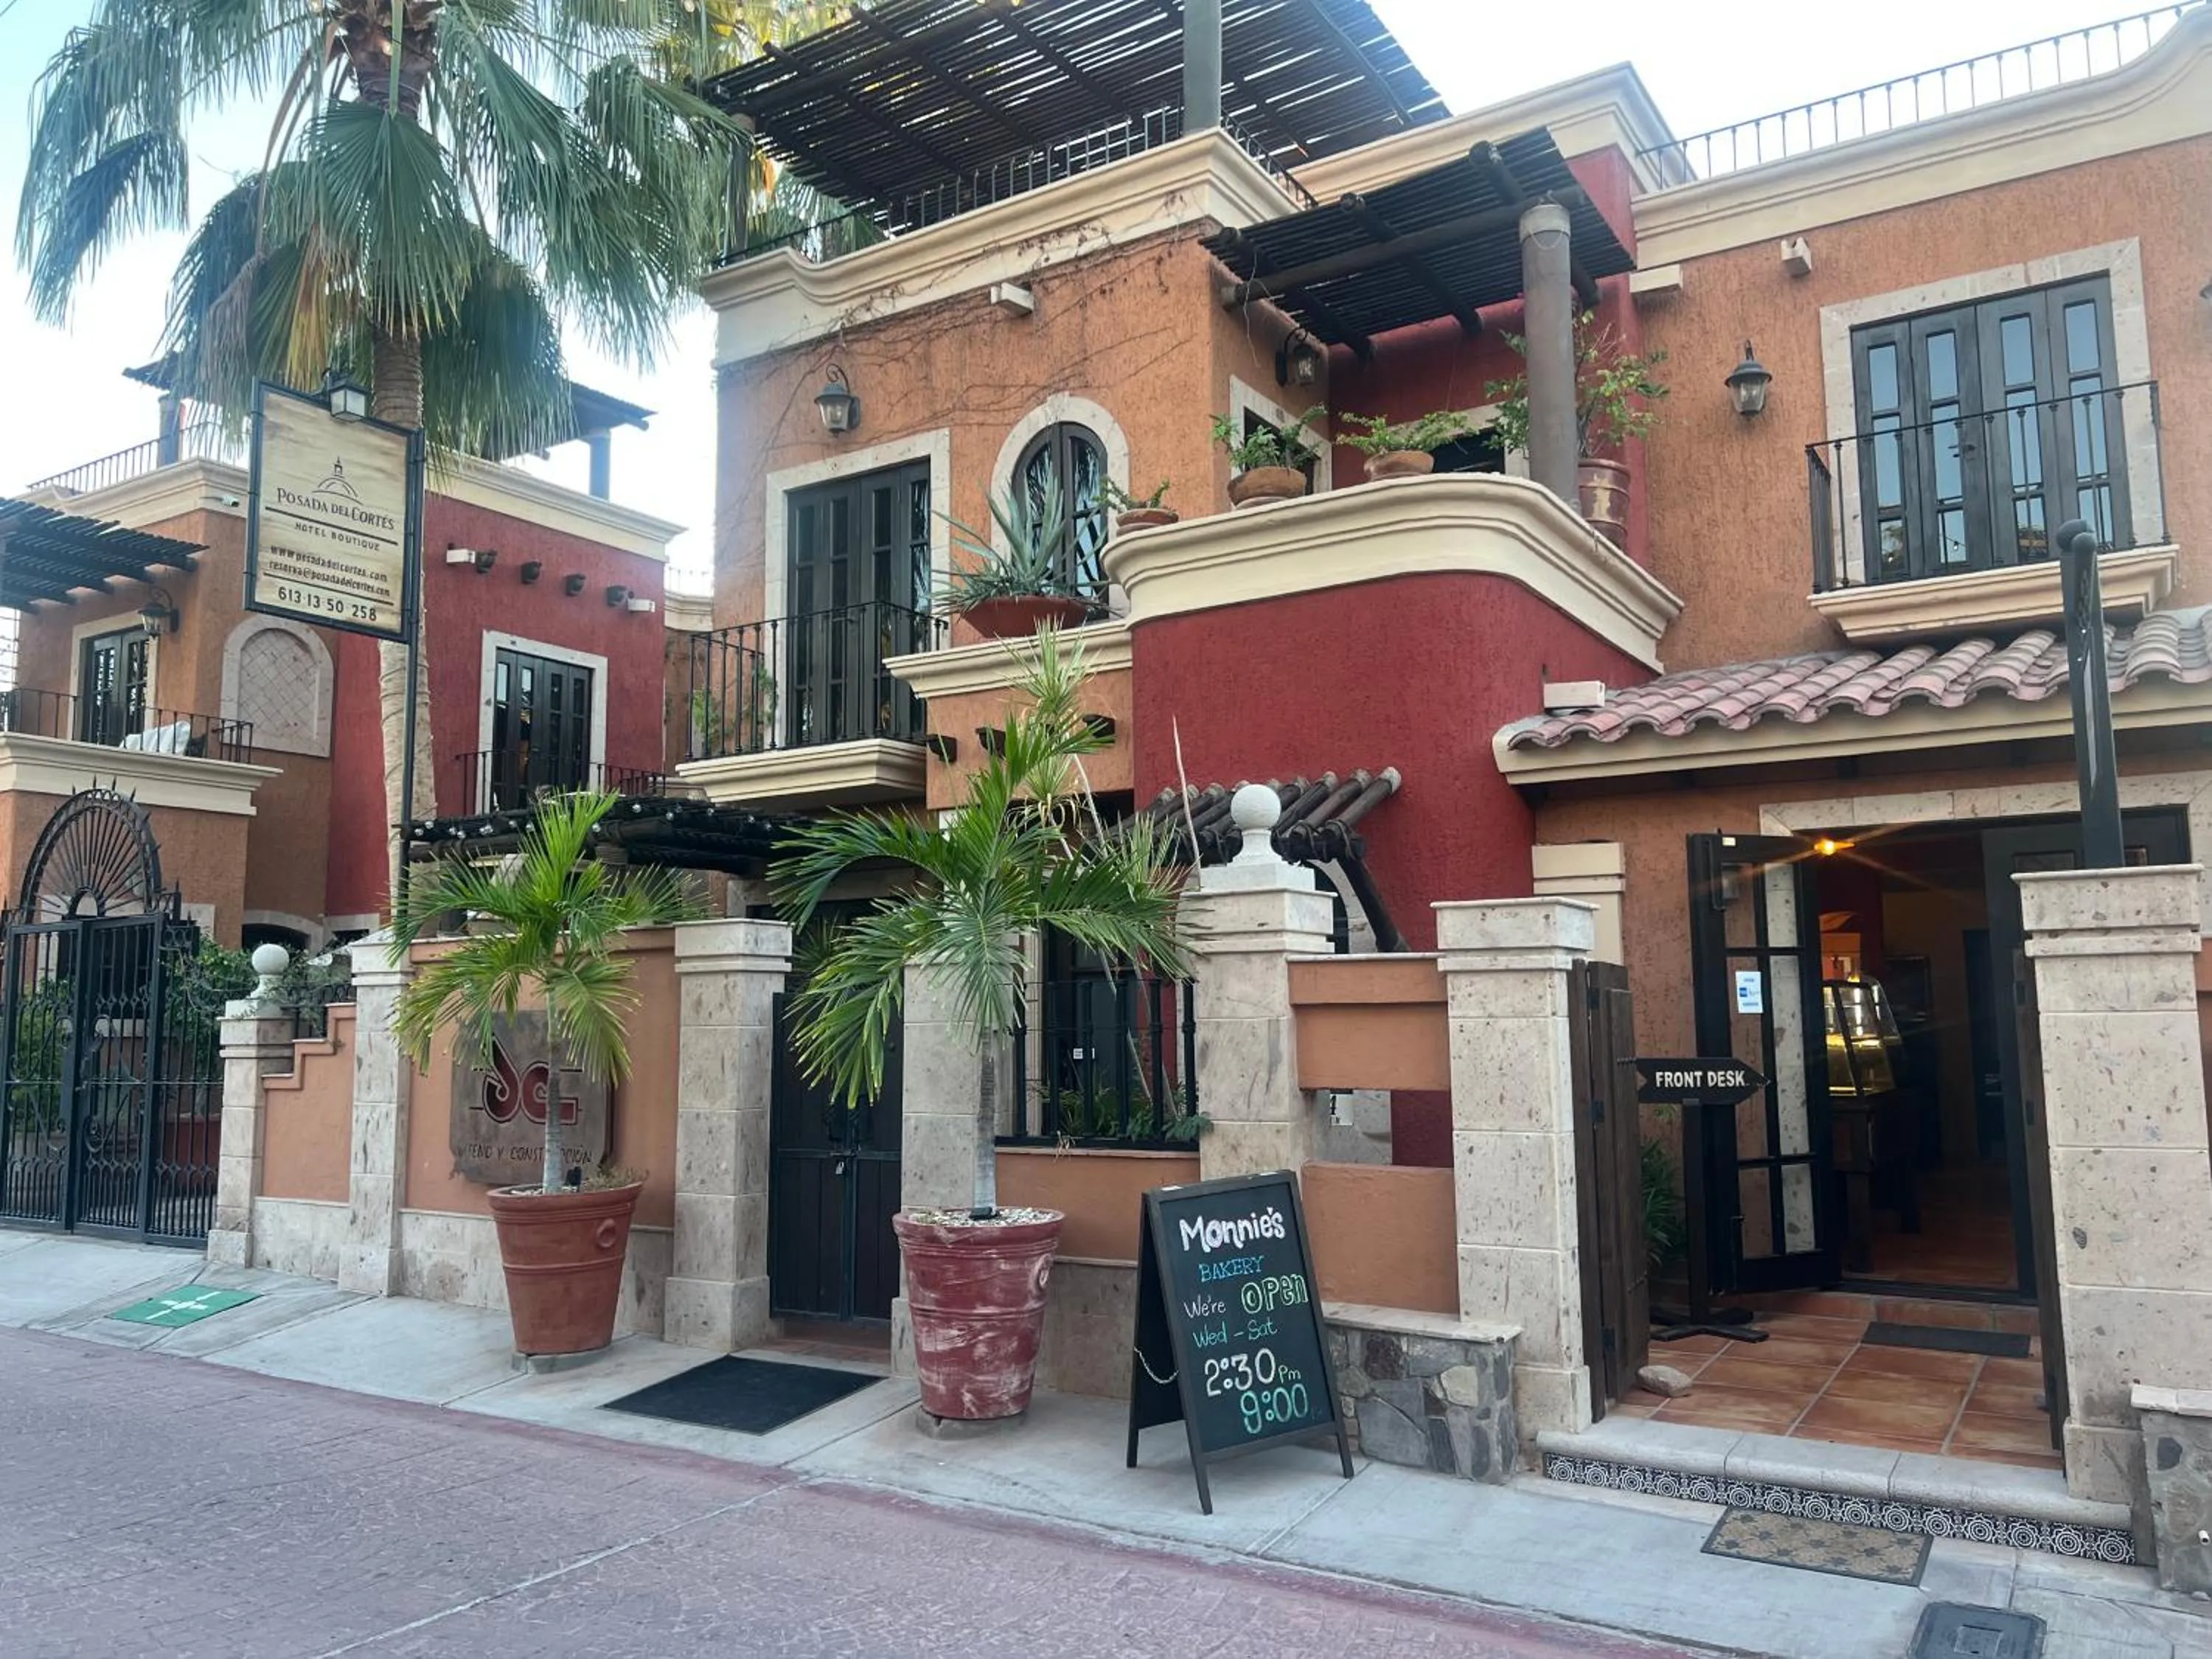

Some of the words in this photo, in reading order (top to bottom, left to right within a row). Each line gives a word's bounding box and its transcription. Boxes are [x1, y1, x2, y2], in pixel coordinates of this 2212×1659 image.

[277, 487, 328, 513] POSADA
[332, 504, 349, 516] DEL
[295, 522, 326, 538] HOTEL
[331, 532, 380, 552] BOUTIQUE
[278, 586, 302, 604] 613
[307, 594, 321, 608] 13
[327, 599, 344, 613] 50
[352, 604, 377, 622] 258
[1655, 1071, 1703, 1088] FRONT
[1708, 1071, 1745, 1088] DESK
[1179, 1206, 1286, 1253] Monnie's
[1198, 1255, 1265, 1282] BAKERY
[1183, 1293, 1226, 1318] We're
[1192, 1321, 1228, 1349] Wed
[1247, 1316, 1278, 1340] Sat
[1204, 1348, 1276, 1397] 2:30
[1240, 1383, 1309, 1434] 9:00
